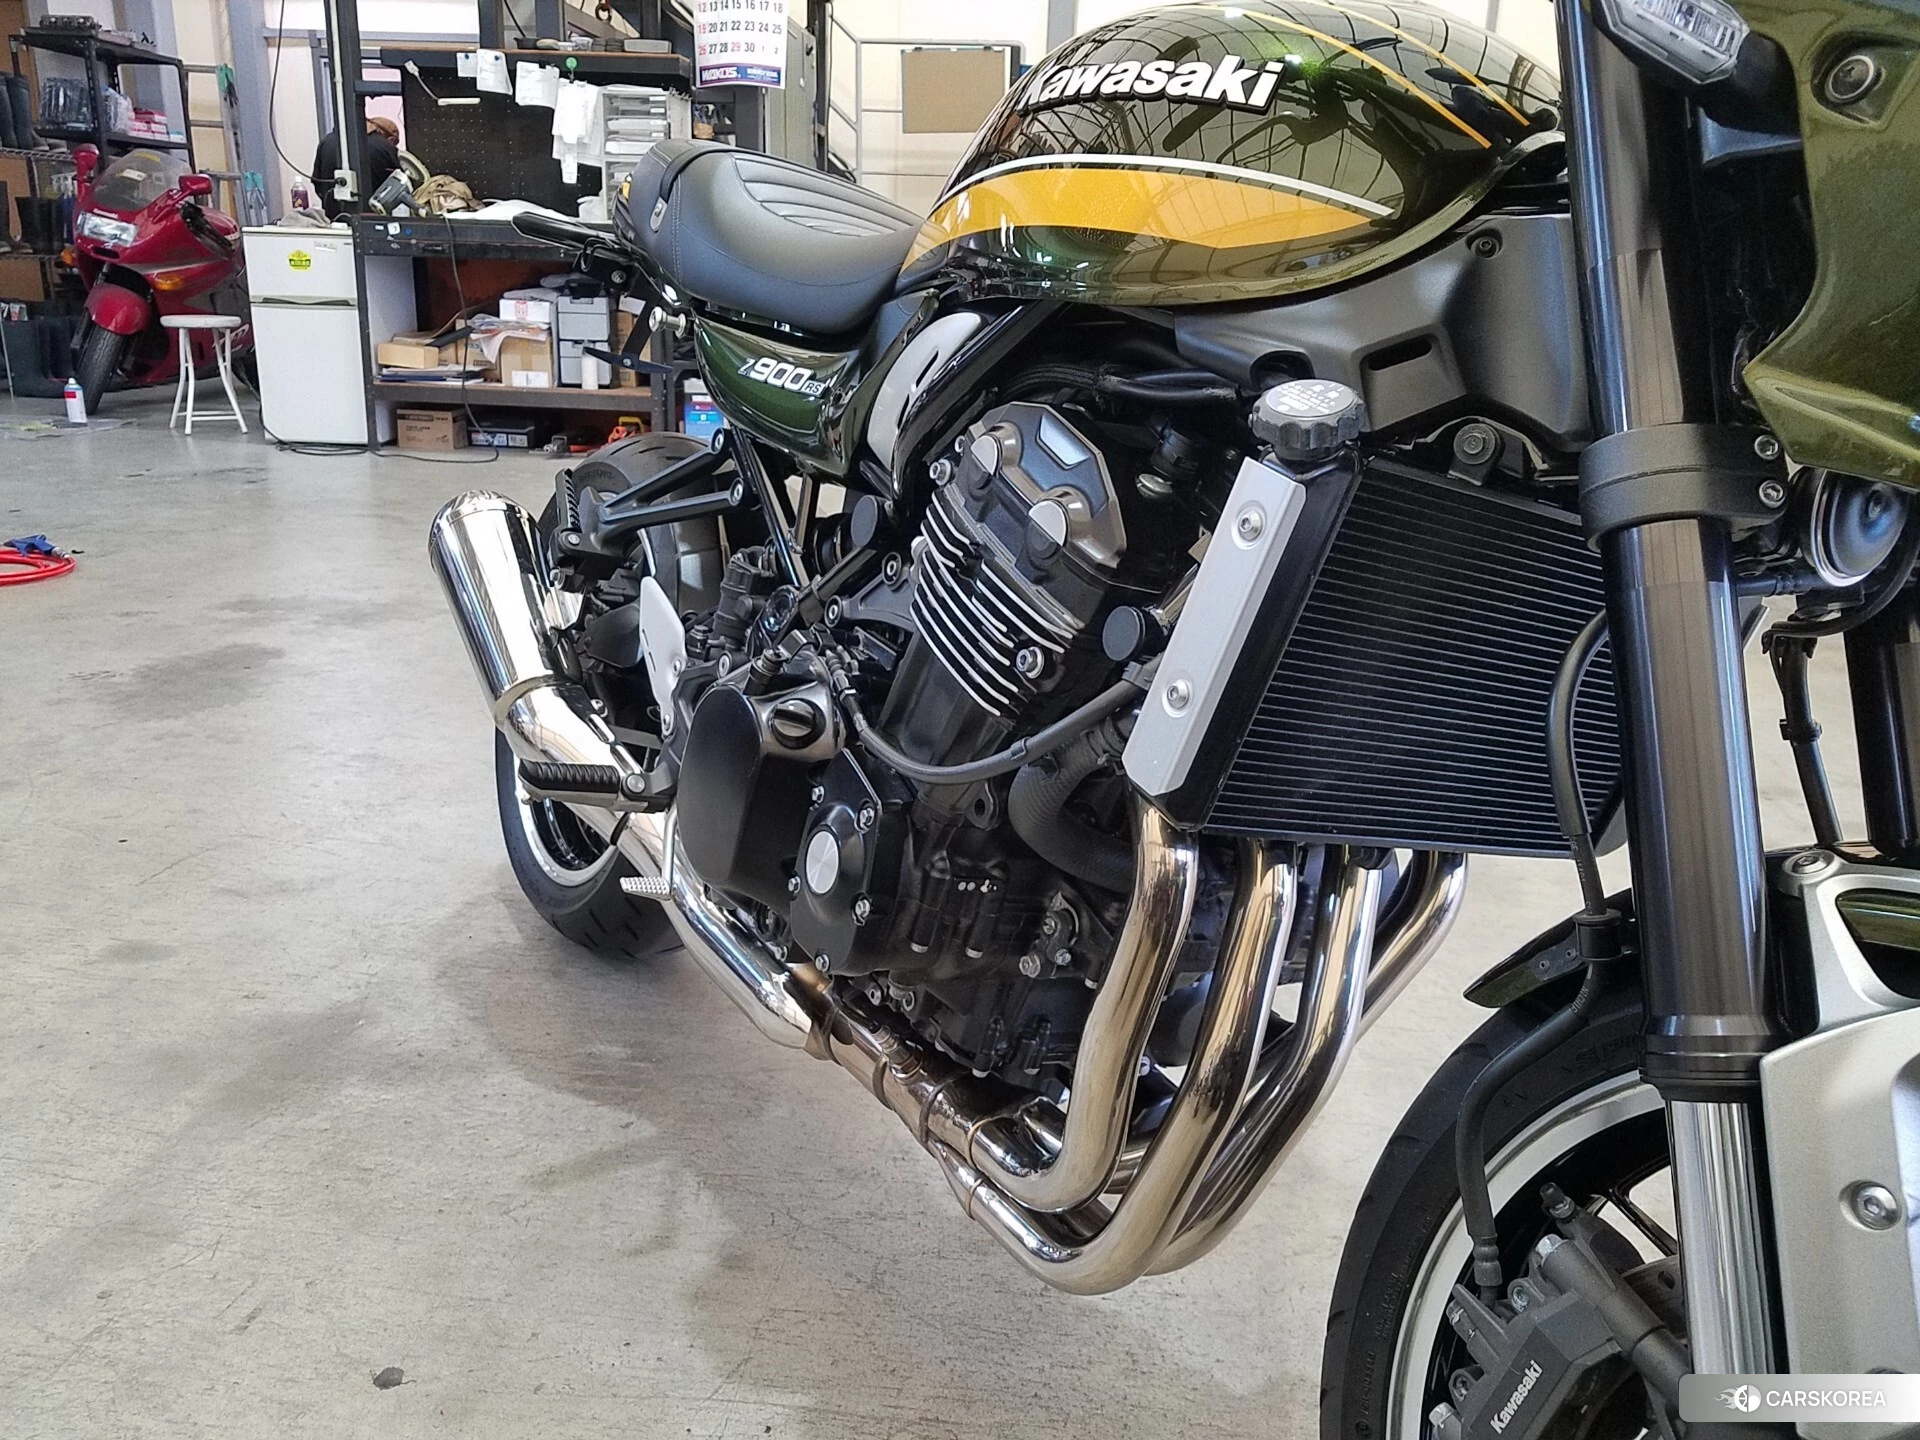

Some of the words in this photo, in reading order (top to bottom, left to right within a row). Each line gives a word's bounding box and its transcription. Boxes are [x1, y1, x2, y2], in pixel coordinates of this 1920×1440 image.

[698, 3, 707, 13] 12
[709, 1, 718, 12] 13
[720, 0, 729, 11] 14
[732, 0, 741, 10] 15
[746, 0, 755, 10] 16
[759, 1, 769, 11] 17
[773, 2, 783, 13] 18
[708, 23, 718, 33] 20
[720, 21, 728, 32] 21
[731, 20, 741, 31] 22
[744, 21, 755, 31] 23
[758, 22, 769, 32] 24
[772, 23, 782, 35] 25
[698, 44, 707, 56] 26
[708, 43, 718, 54] 27
[719, 42, 729, 53] 28
[731, 41, 741, 52] 29
[744, 42, 755, 53] 30
[1018, 54, 1286, 110] Kawasaki
[1490, 1359, 1543, 1435] Kawasaki
